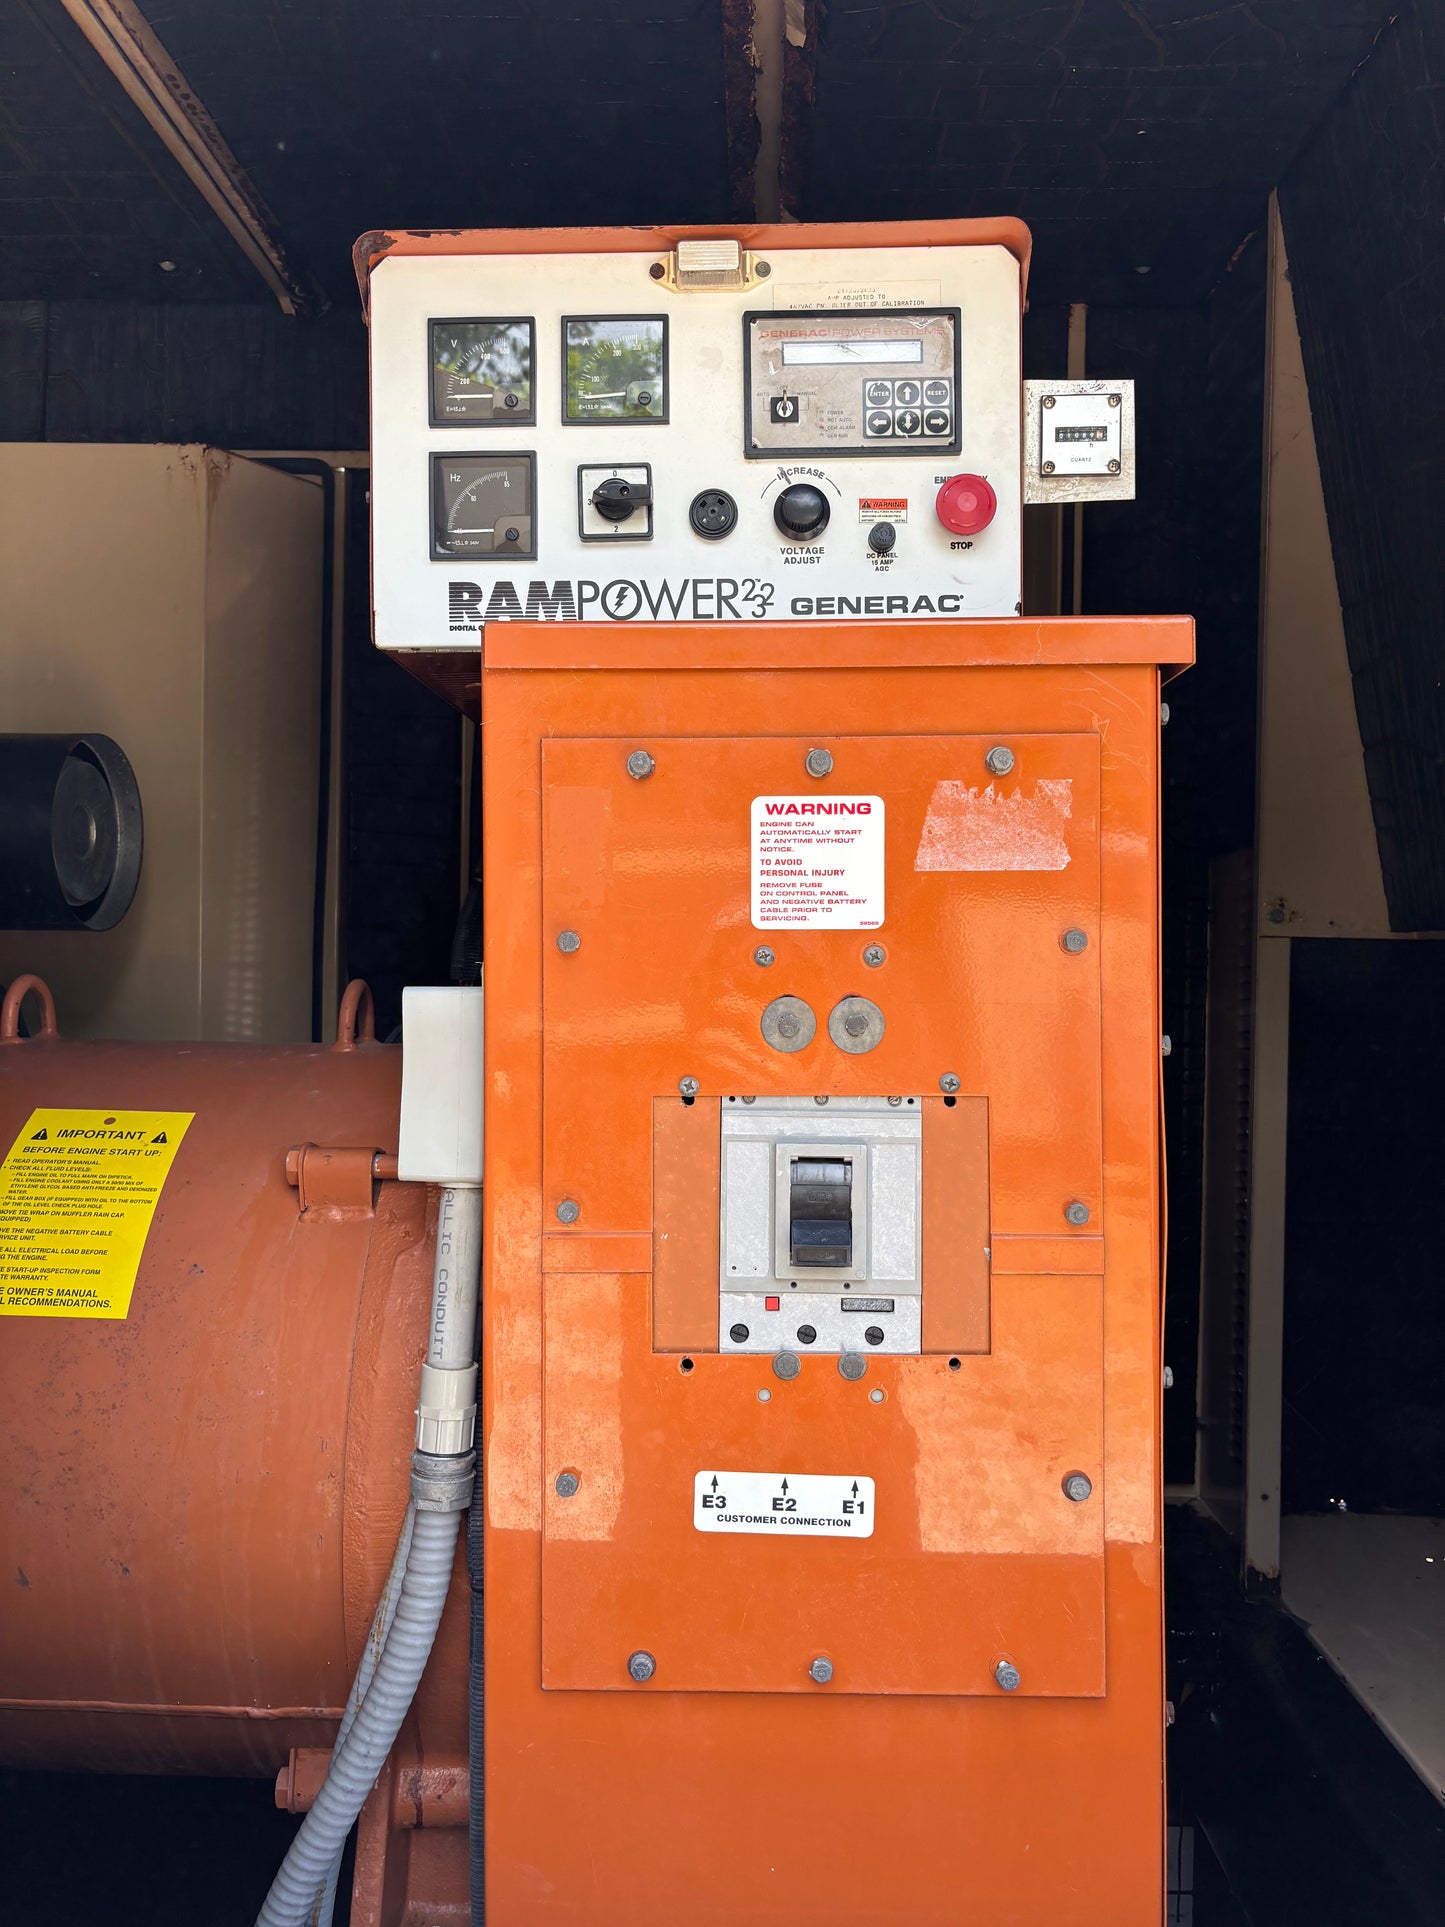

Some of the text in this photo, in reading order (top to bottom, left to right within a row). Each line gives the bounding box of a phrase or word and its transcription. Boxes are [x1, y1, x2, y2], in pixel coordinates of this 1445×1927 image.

[451, 339, 457, 348] V
[450, 474, 461, 482] Hz
[777, 467, 825, 480] INCREASE
[791, 595, 960, 615] GENERAC
[766, 803, 872, 815] WARNING
[56, 1129, 146, 1140] IMPORTANT
[7, 1288, 54, 1296] OWNER'S
[56, 1289, 98, 1297] MANUAL
[8, 1297, 112, 1308] RECOMMENDATIONS.
[433, 1268, 448, 1359] CONDUIT
[702, 1495, 864, 1514] E3 E2 E1
[717, 1514, 851, 1527] CUSTOMER CONNECTION
